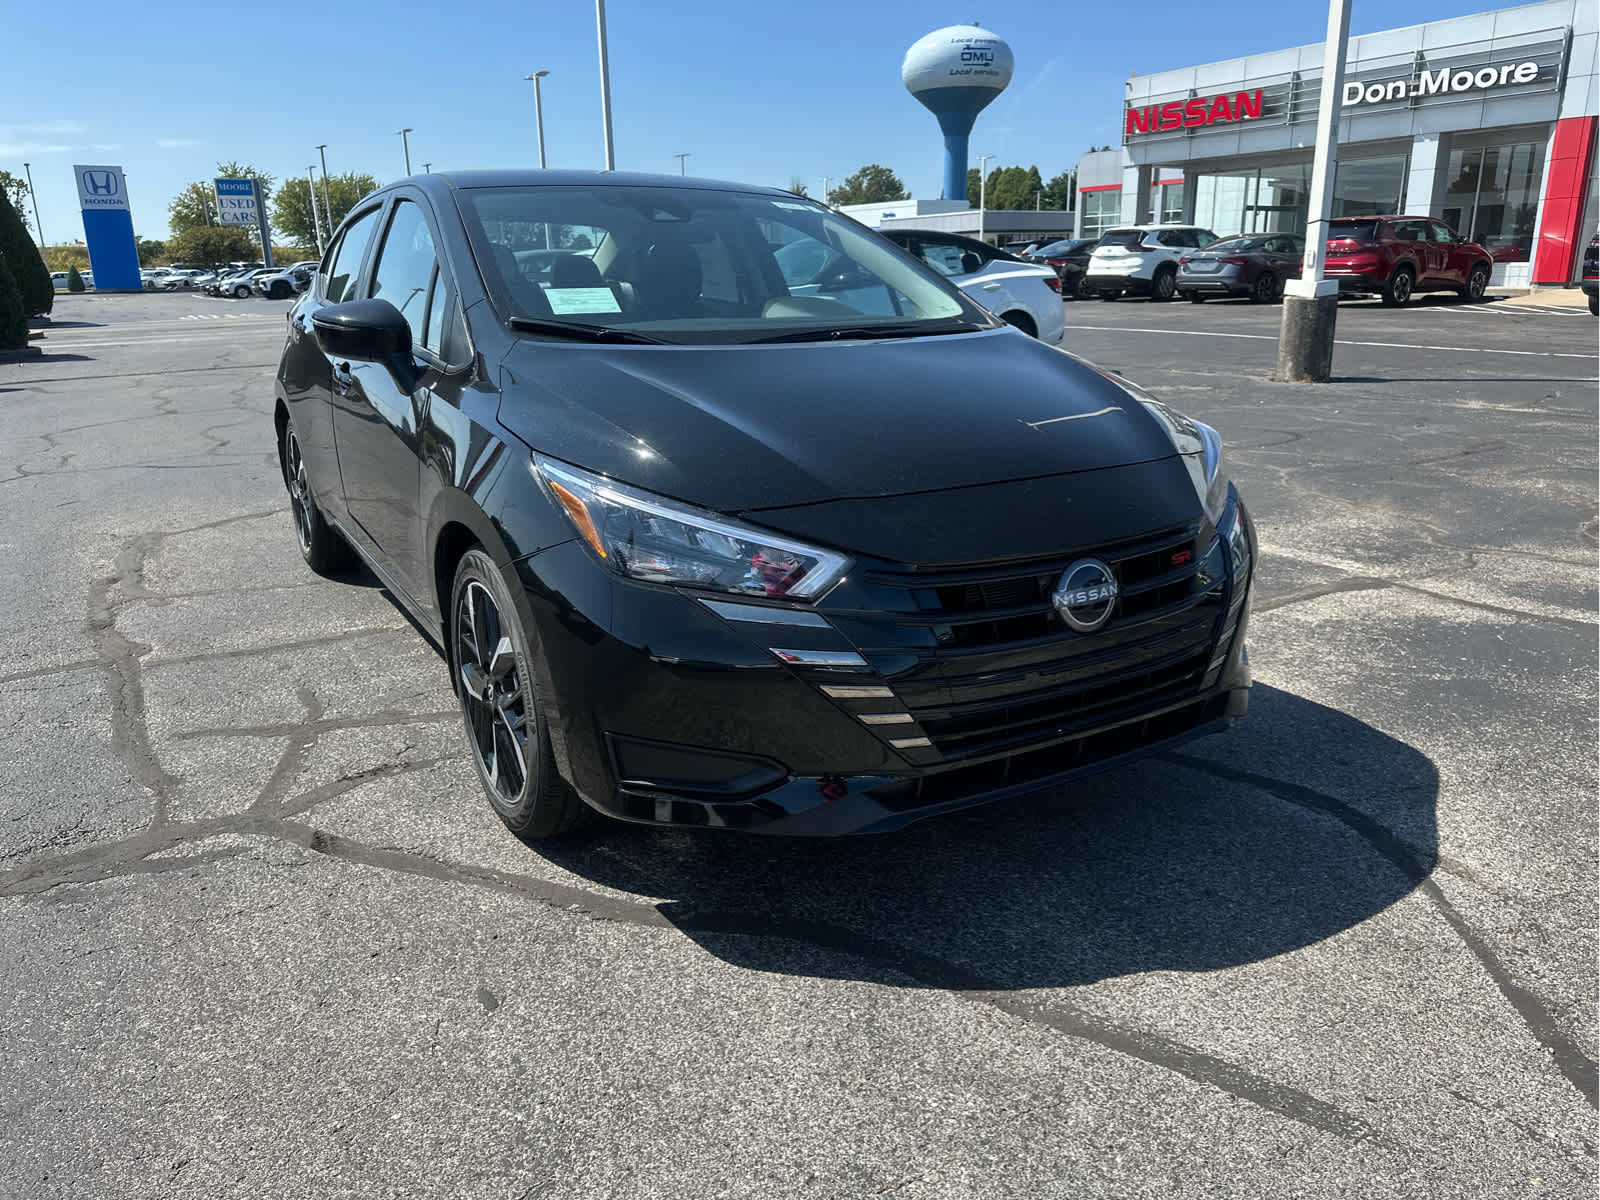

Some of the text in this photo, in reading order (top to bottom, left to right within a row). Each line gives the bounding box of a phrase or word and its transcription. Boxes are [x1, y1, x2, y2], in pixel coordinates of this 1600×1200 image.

[1342, 62, 1539, 106] Don Moore
[1126, 89, 1263, 135] NISSAN
[218, 182, 251, 192] MOORE
[84, 198, 124, 206] HONDA
[219, 199, 255, 209] USED
[221, 211, 257, 223] CARS
[1054, 583, 1118, 608] NISSAN
